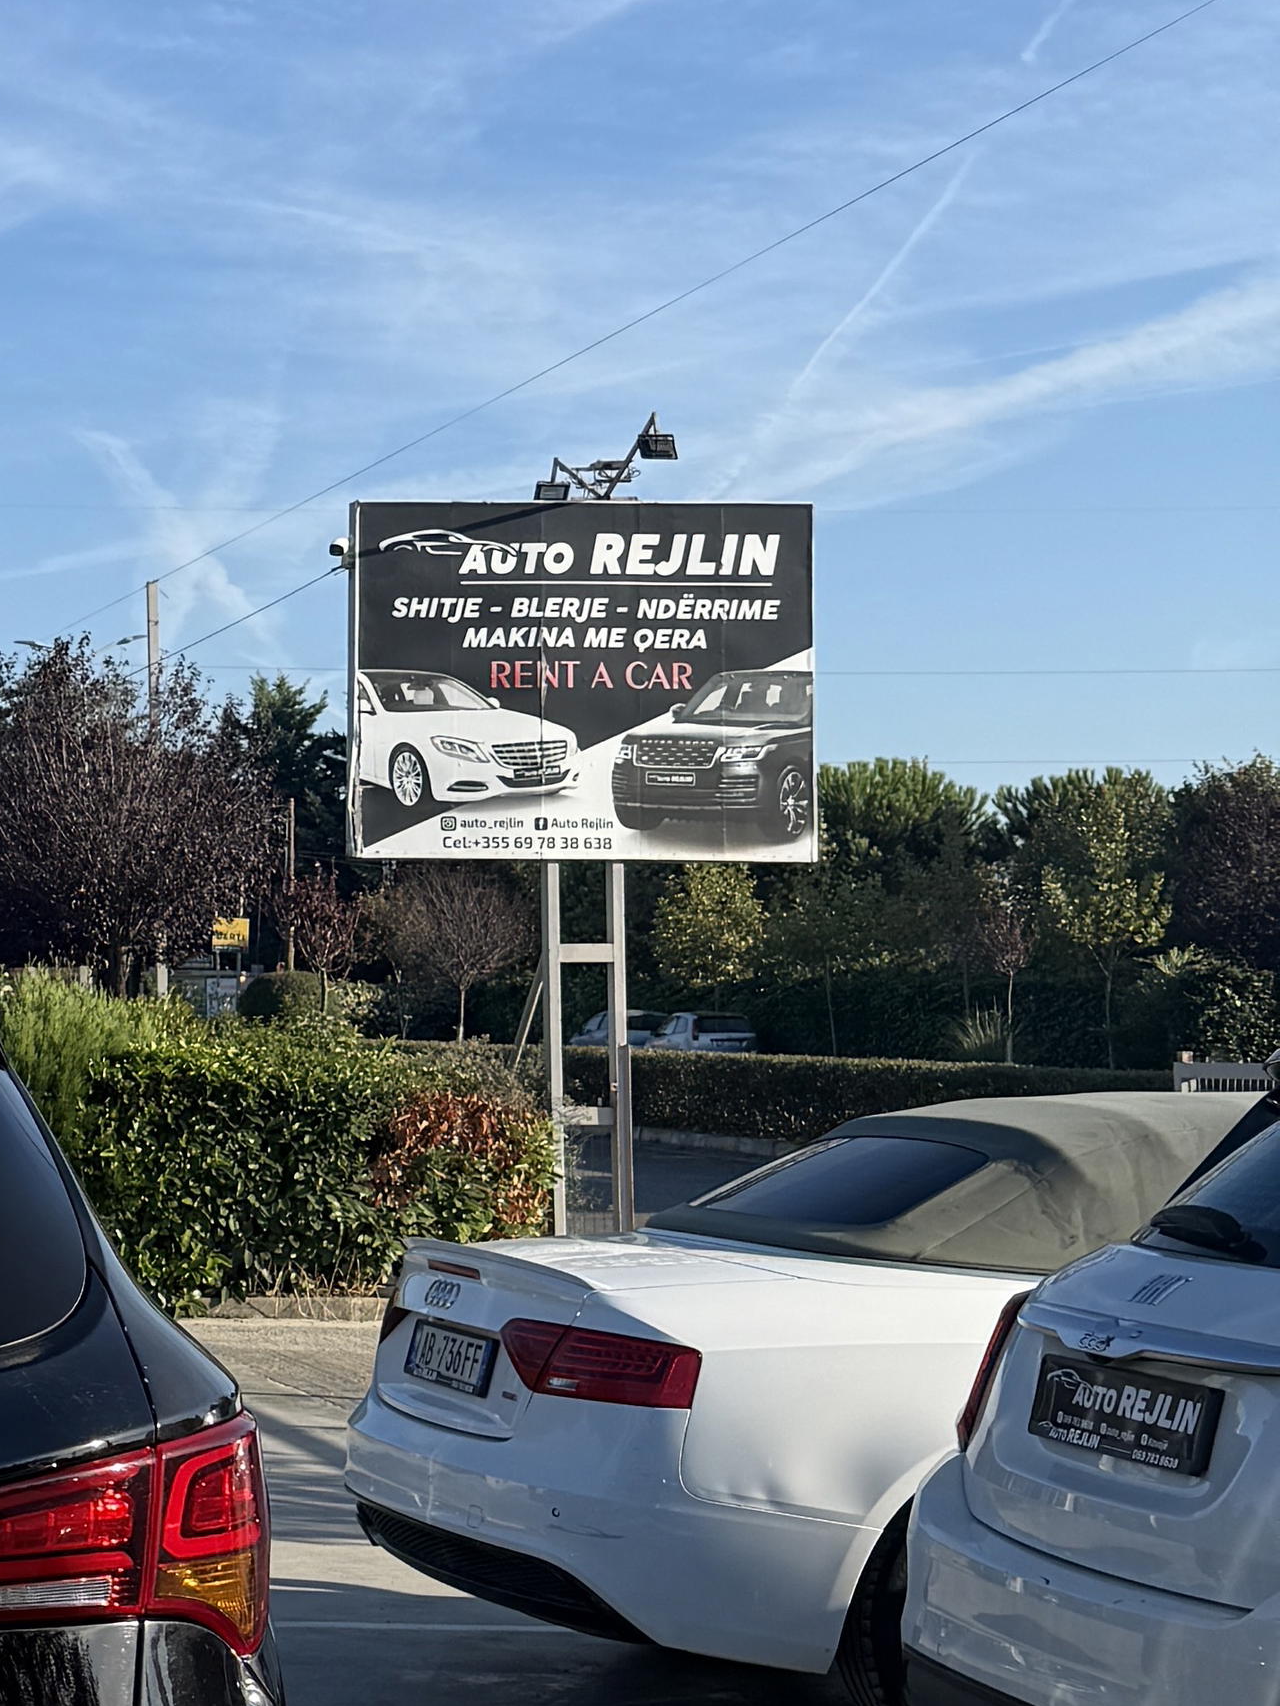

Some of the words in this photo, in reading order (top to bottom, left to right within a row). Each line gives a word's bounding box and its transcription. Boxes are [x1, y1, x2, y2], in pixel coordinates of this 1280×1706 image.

[458, 541, 575, 576] AUTO
[589, 533, 781, 576] REJLIN
[391, 596, 483, 624] SHITJE
[510, 597, 610, 624] BLERJE
[636, 593, 781, 621] NDËRRIME
[462, 626, 576, 648] MAKINA
[583, 627, 628, 649] ME
[633, 628, 708, 653] QERA
[488, 659, 580, 691] RENT
[590, 660, 614, 690] A
[624, 660, 693, 690] CAR
[459, 816, 525, 832] auto_rejlin
[551, 817, 577, 829] Auto
[442, 836, 510, 849] Cel:+355
[513, 836, 533, 850] 69
[537, 836, 556, 850] 78
[560, 836, 579, 850] 38
[583, 837, 612, 850] 638
[1072, 1384, 1117, 1414] AUTO
[1117, 1385, 1202, 1435] REJLIN
[1067, 1427, 1101, 1450] REJLIN
